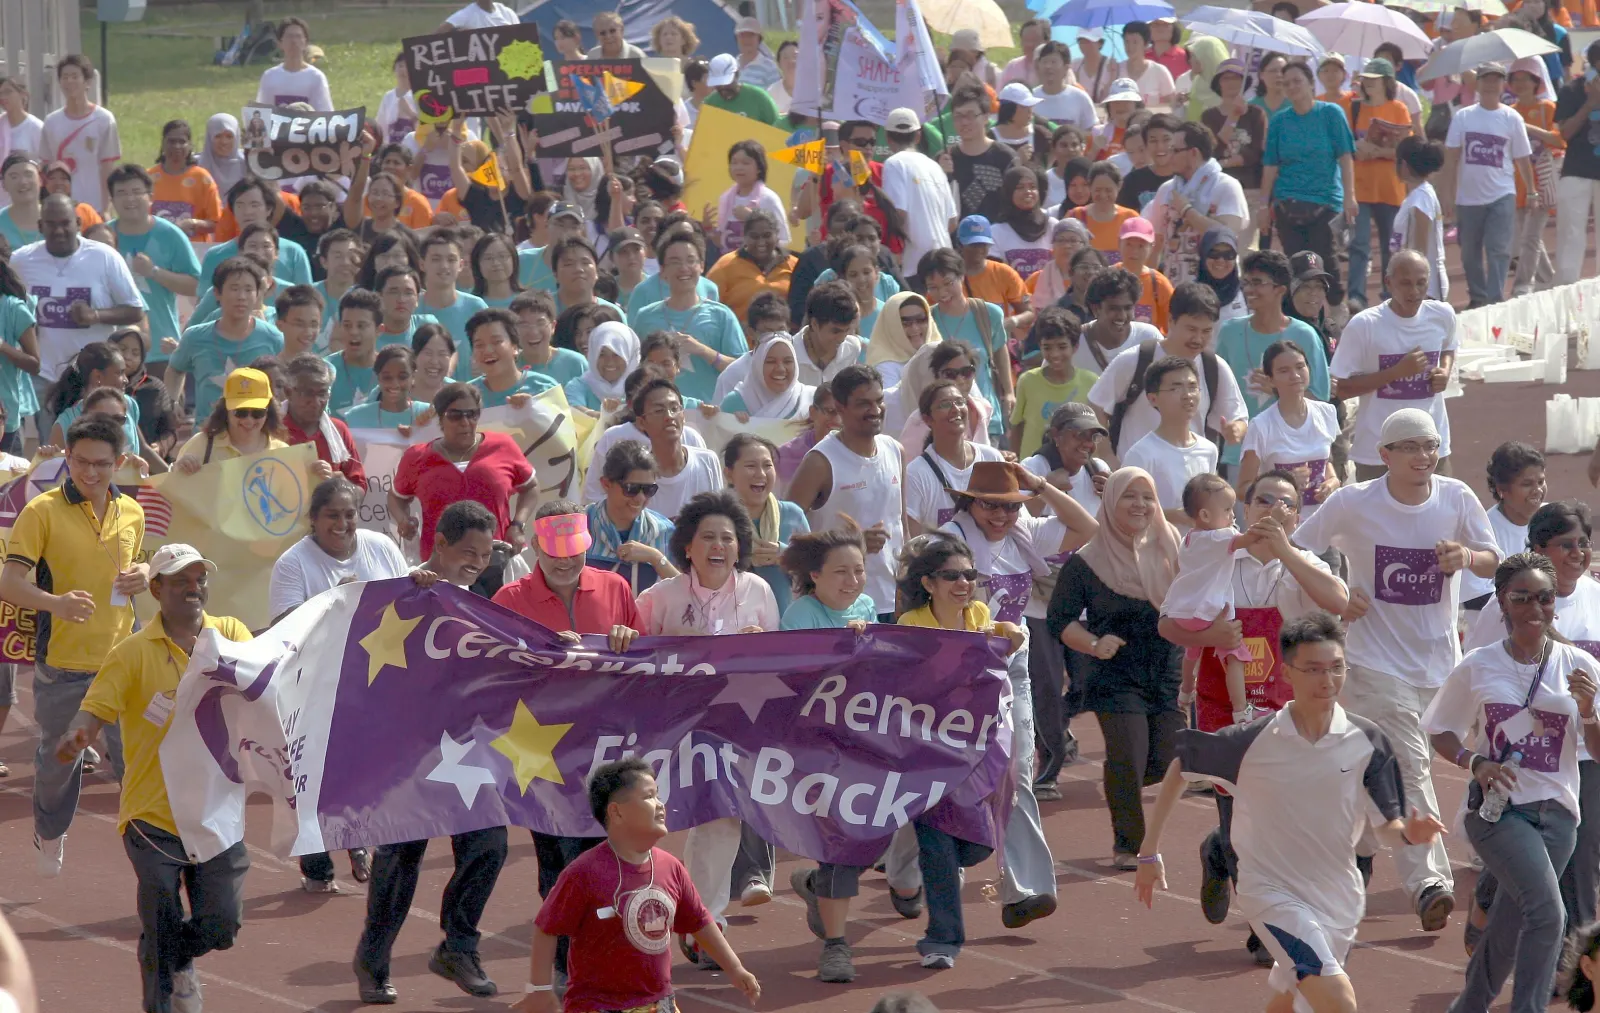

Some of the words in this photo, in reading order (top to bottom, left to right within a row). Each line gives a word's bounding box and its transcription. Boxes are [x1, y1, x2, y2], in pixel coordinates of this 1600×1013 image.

[410, 33, 500, 70] RELAY
[427, 69, 447, 96] 4
[449, 83, 524, 113] LIFE
[269, 112, 358, 144] TEAM
[247, 146, 362, 180] COOK
[1396, 572, 1437, 584] HOPE
[750, 746, 947, 830] Back!
